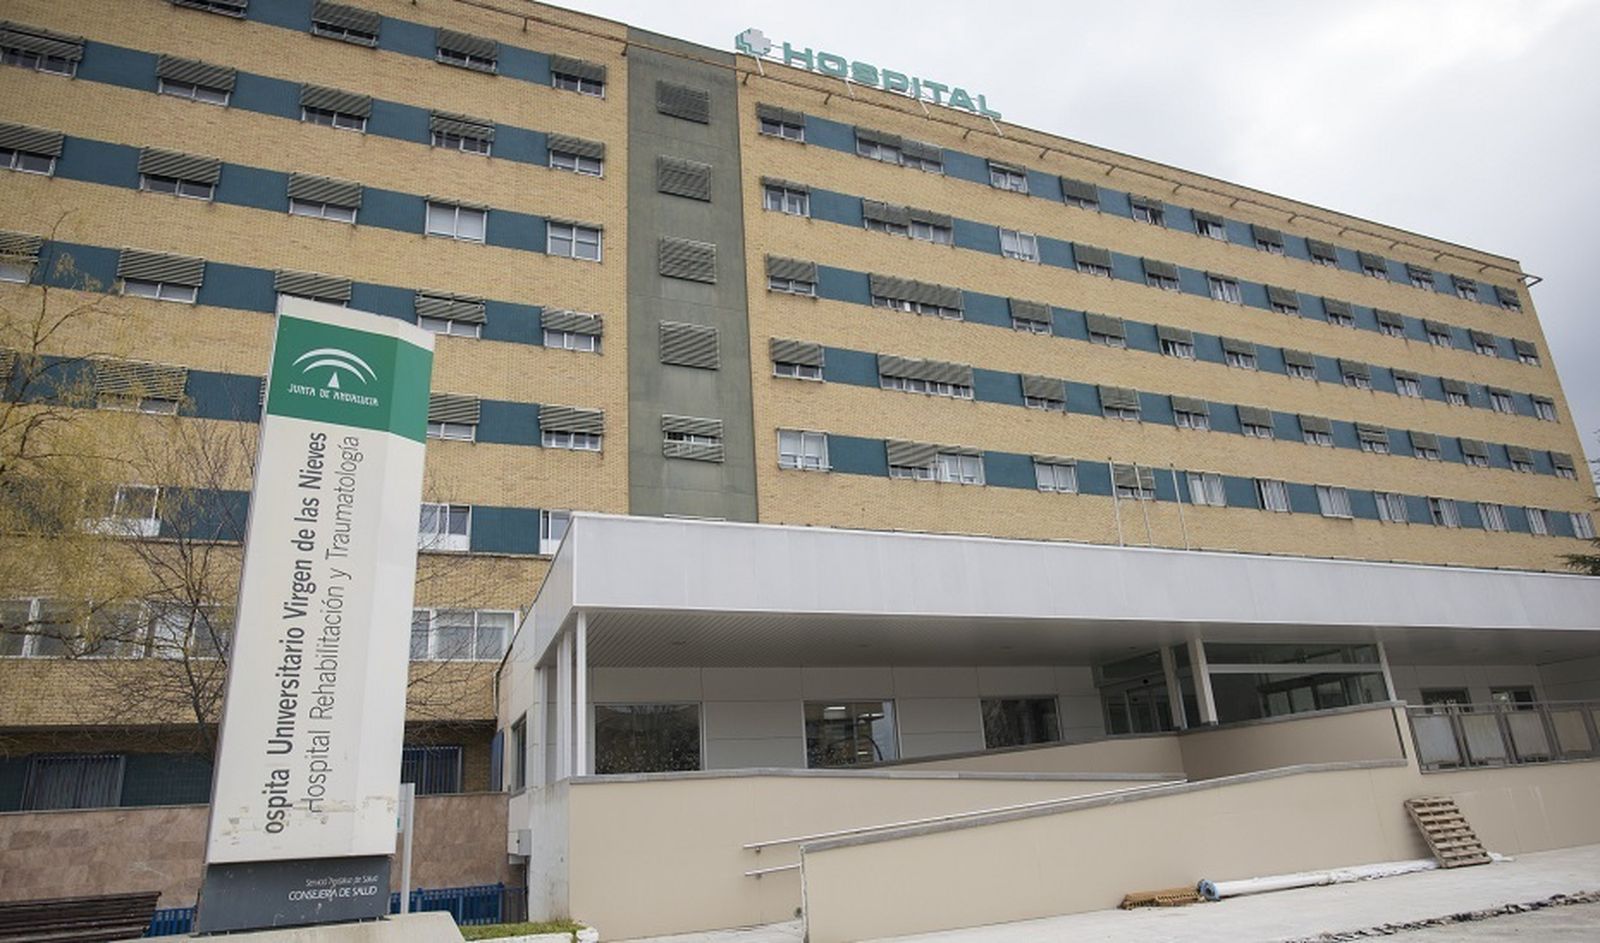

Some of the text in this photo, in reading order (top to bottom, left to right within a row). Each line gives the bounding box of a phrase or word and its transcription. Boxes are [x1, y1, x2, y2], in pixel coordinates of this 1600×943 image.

[783, 42, 1002, 120] HOSPITAL
[287, 383, 316, 397] JUNTA
[319, 388, 331, 399] DE
[298, 432, 327, 490] Nieves
[293, 497, 320, 523] las
[290, 528, 316, 551] de
[282, 559, 317, 619] Virgen
[300, 436, 364, 813] Hospital Rehabilitación y Traumatología
[266, 627, 305, 755] Universitario
[338, 887, 351, 897] DE
[352, 885, 378, 896] SALUD
